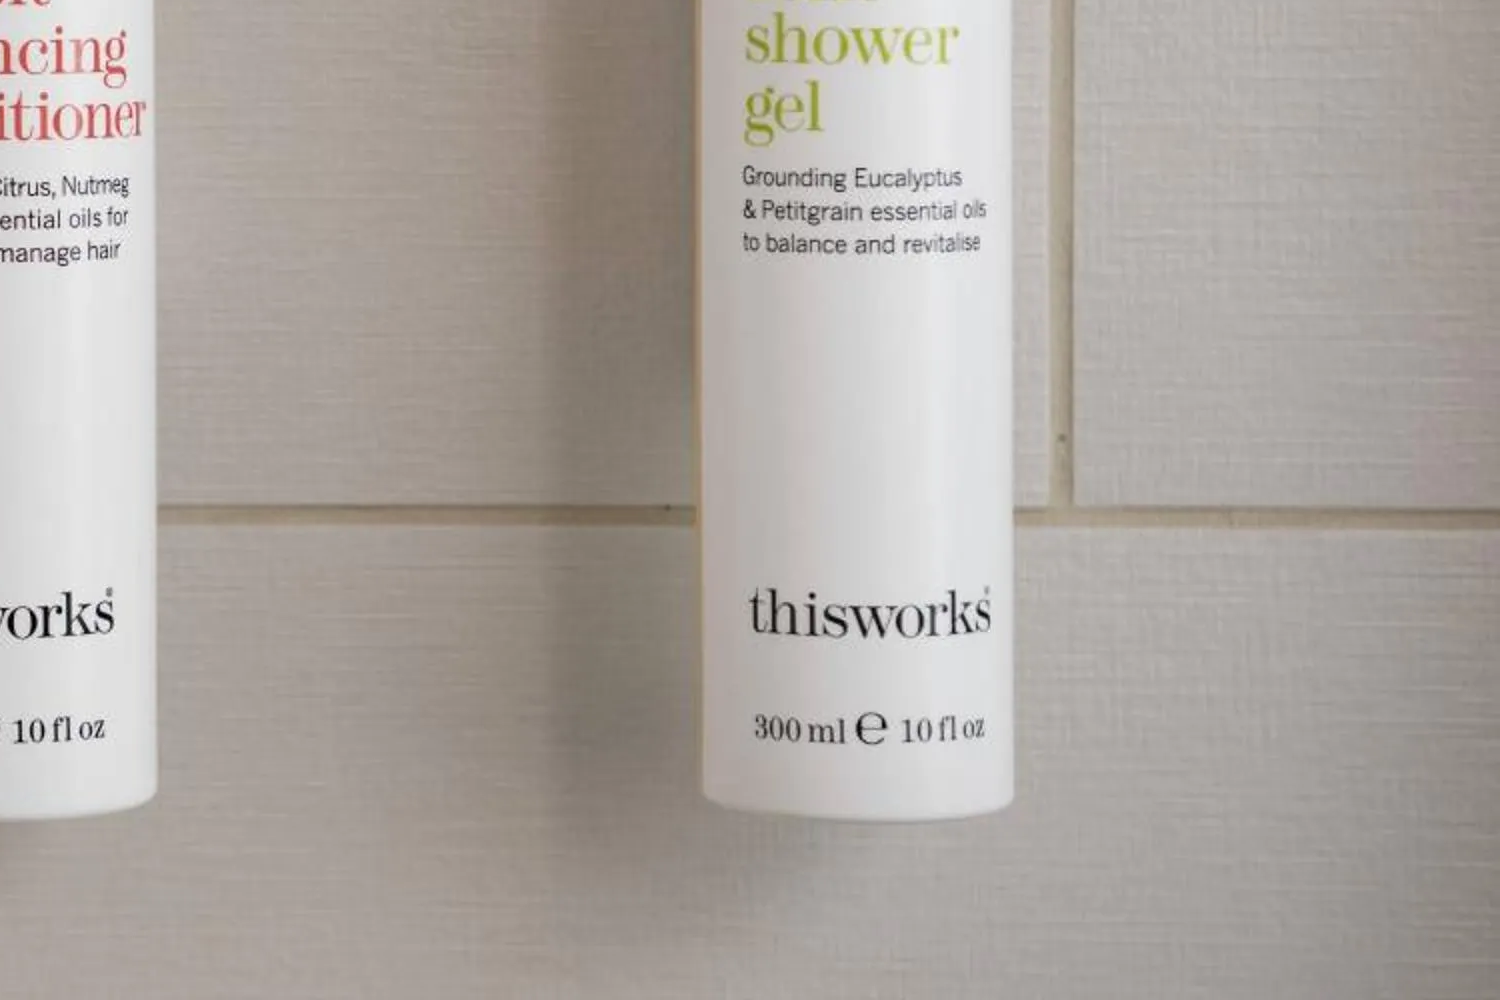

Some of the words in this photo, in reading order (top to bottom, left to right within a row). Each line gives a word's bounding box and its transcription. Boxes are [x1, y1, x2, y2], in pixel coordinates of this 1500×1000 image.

[745, 11, 960, 66] shower
[743, 80, 825, 147] gel
[62, 174, 130, 198] Nutmeg
[742, 165, 847, 192] Grounding
[856, 167, 963, 193] Eucalyptus
[69, 207, 102, 229] oils
[106, 206, 128, 228] for
[743, 199, 757, 220] &
[762, 200, 863, 226] Petitgrain
[871, 200, 957, 222] essential
[964, 199, 986, 219] oils
[87, 239, 122, 261] hair
[743, 233, 760, 252] to
[766, 234, 847, 255] balance
[855, 235, 895, 255] and
[903, 233, 981, 254] revitalise
[14, 718, 45, 744] 10
[52, 716, 72, 742] fl
[79, 718, 106, 740] oz
[754, 713, 801, 742] 300
[808, 718, 845, 744] ml
[902, 718, 932, 743] 10
[940, 716, 956, 741] fl
[964, 717, 985, 739] oz
